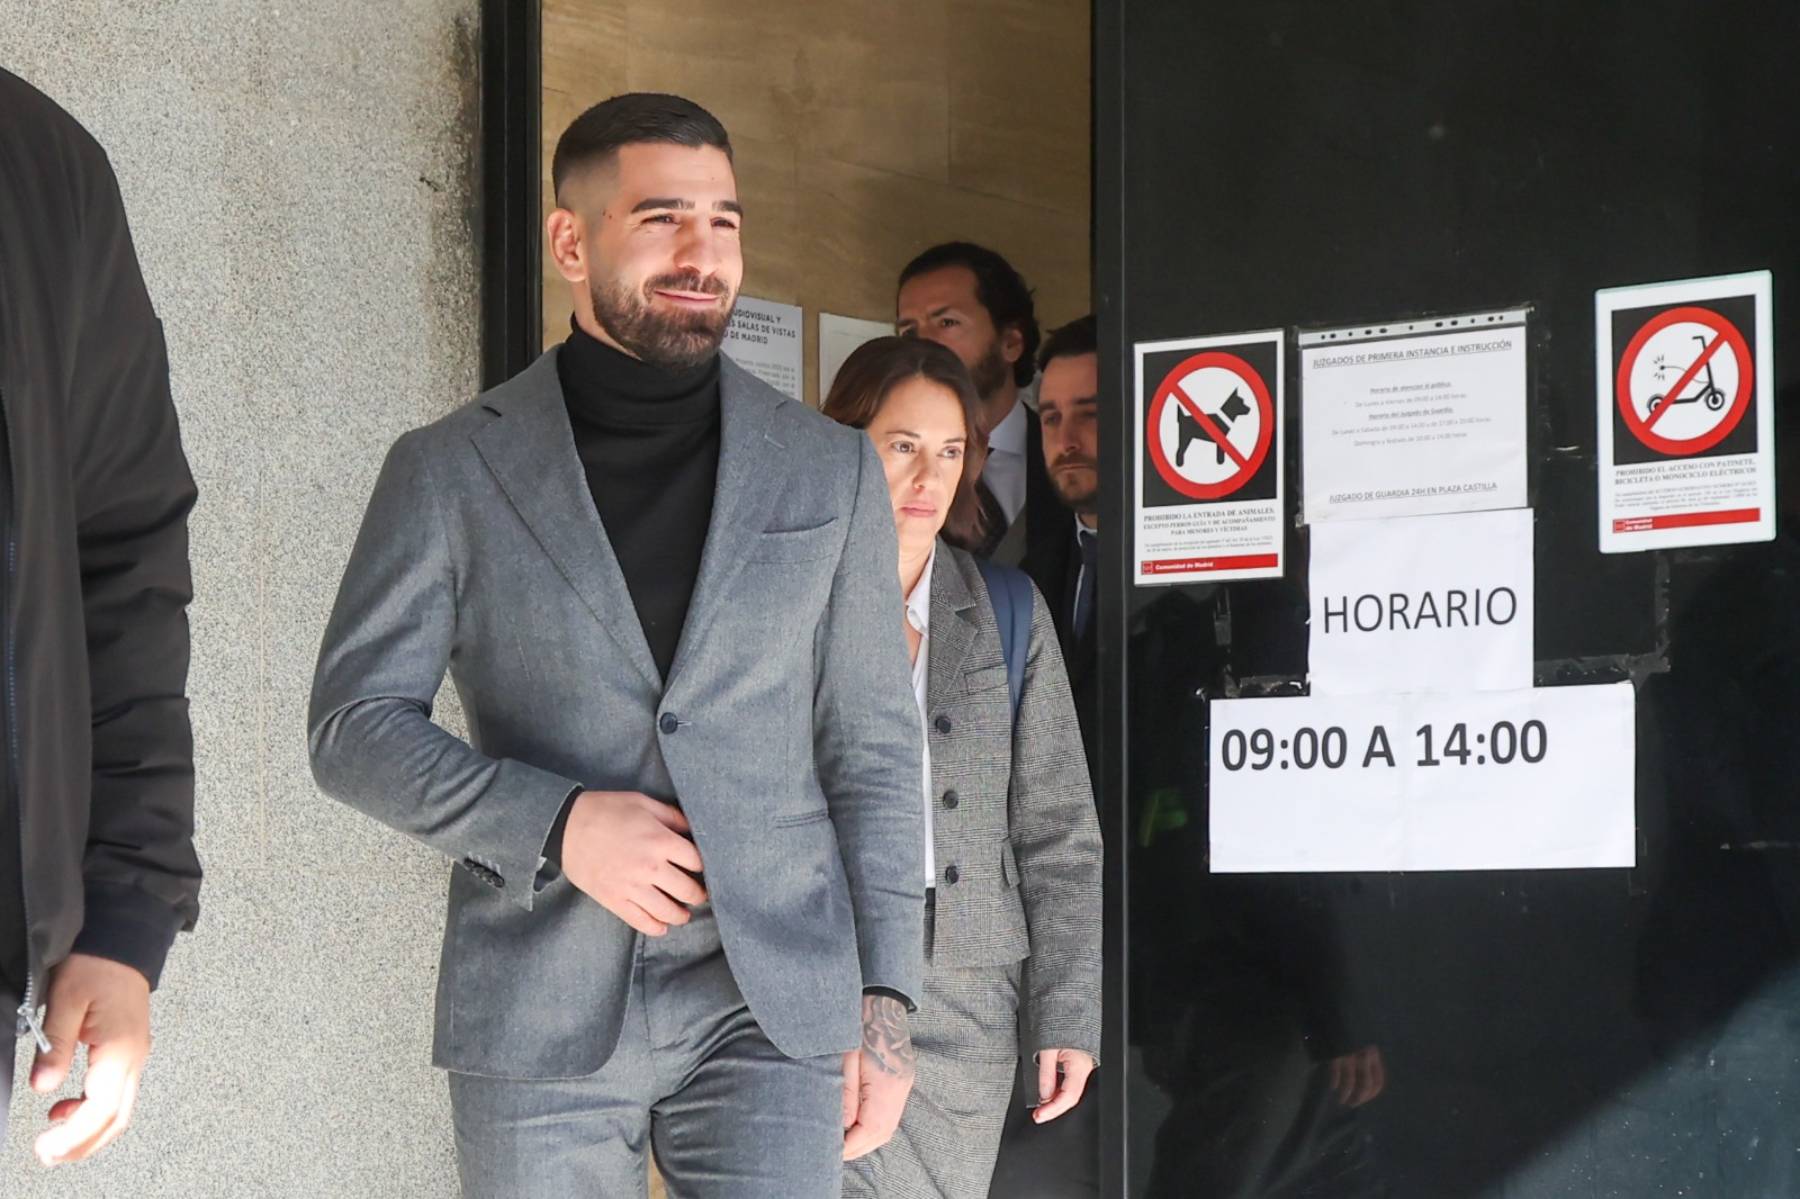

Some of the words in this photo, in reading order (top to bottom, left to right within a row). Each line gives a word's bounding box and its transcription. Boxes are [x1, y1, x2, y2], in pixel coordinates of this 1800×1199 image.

[733, 309, 775, 323] UDIOVISUAL
[730, 330, 739, 340] DE
[741, 333, 768, 344] MADRID
[737, 321, 759, 331] SALAS
[761, 325, 770, 334] DE
[772, 327, 796, 338] VISTAS
[1313, 356, 1354, 368] JUZGADOS
[1355, 354, 1366, 363] DE
[1368, 351, 1404, 362] PRIMERA
[1406, 346, 1448, 359] INSTANCIA
[1458, 339, 1512, 353] INSTRUCCIÓN
[1614, 476, 1653, 484] BICICLETA
[1662, 472, 1707, 480] MONOCICLO
[1329, 492, 1362, 503] JUZGADO
[1364, 491, 1373, 500] DE
[1375, 489, 1409, 499] GUARDIA
[1411, 487, 1426, 496] 24H
[1427, 486, 1437, 495] EN
[1438, 485, 1461, 494] PLAZA
[1463, 482, 1497, 492] CASTILLA
[1143, 513, 1181, 521] PROHIBIDO
[1324, 587, 1517, 633] HORARIO
[1222, 726, 1347, 771] 09:00
[1362, 725, 1396, 768] A
[1416, 720, 1547, 767] 14:00
